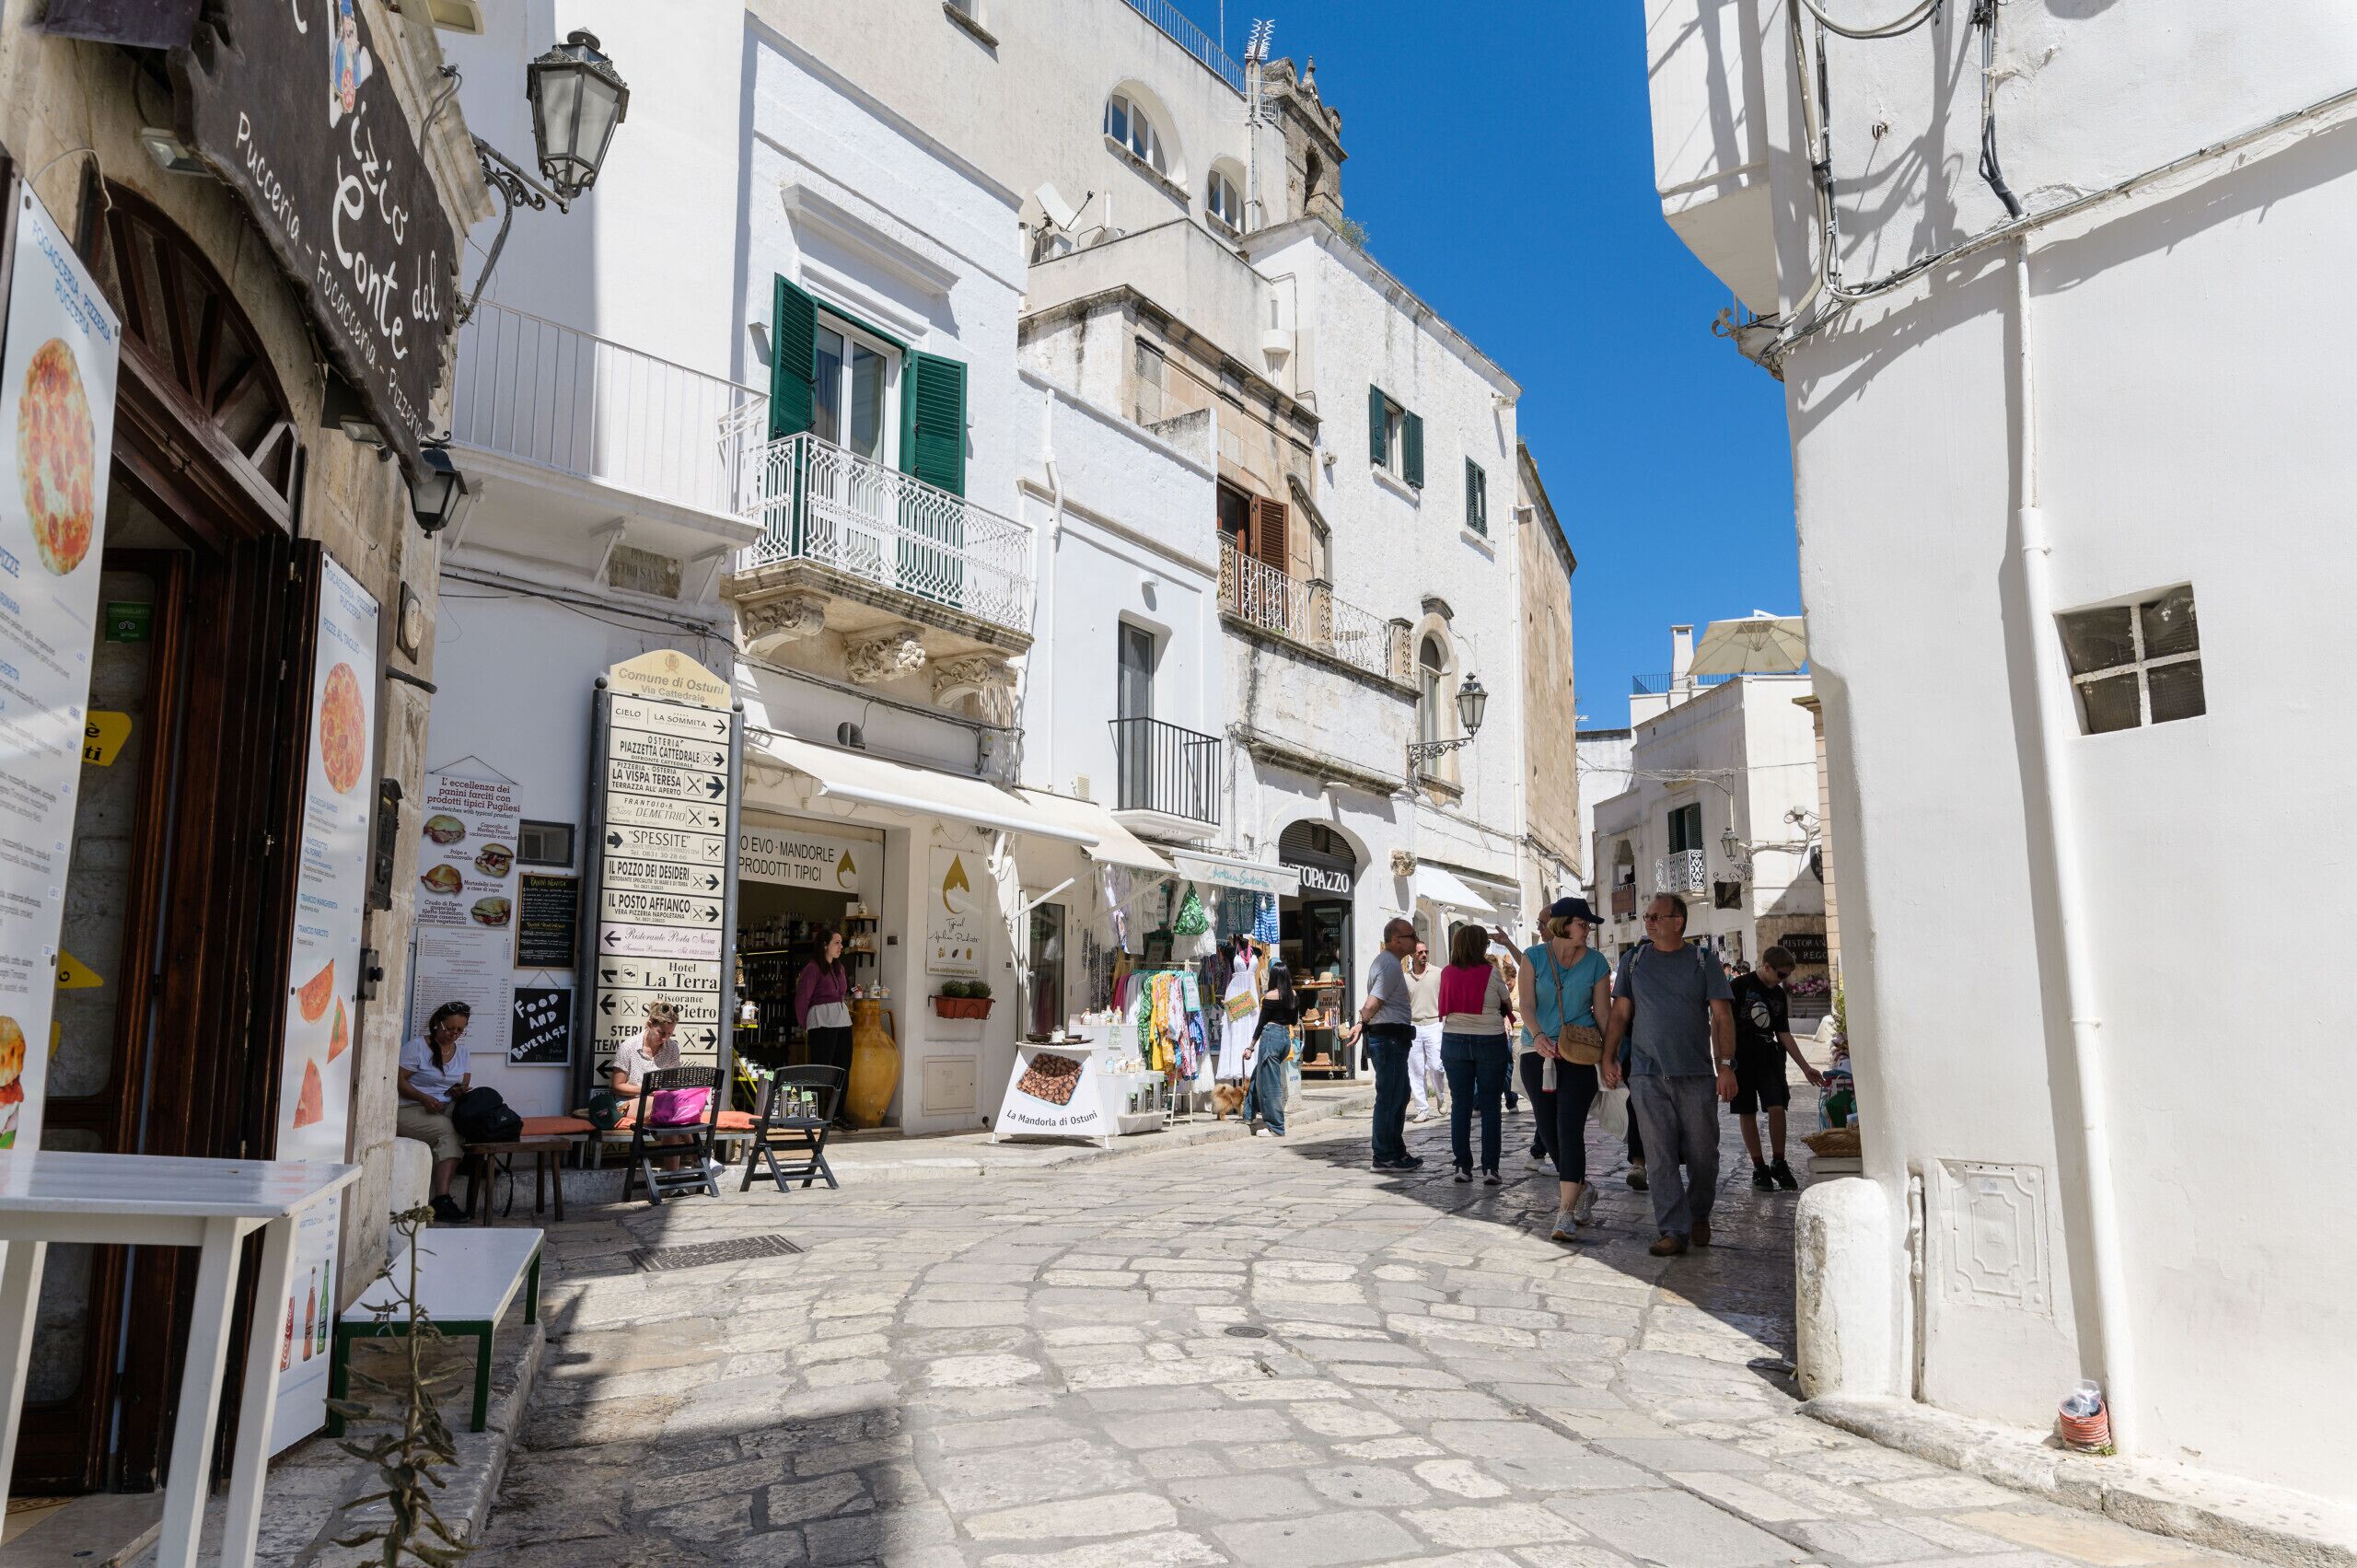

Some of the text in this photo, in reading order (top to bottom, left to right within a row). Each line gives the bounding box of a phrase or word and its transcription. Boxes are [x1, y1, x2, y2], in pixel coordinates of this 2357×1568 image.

[332, 154, 409, 360] Conte
[236, 111, 423, 447] Pucceria Focacceria Pizzeria
[412, 250, 441, 322] del
[619, 668, 725, 695] Comune di Ostuni
[641, 684, 656, 695] Via
[615, 708, 641, 717] CIELO
[667, 715, 707, 727] SOMMITA
[84, 745, 102, 761] ti
[620, 740, 700, 763] PIAZZETTA CATTEDRALE
[617, 761, 677, 774] PIZZERIA OSTERIA
[631, 754, 693, 769] DIFRONTE CATTEDRALE
[612, 768, 681, 787] LA VISPA TERESA
[438, 788, 511, 803] panini farciti con
[449, 781, 494, 792] eccellenza
[496, 784, 510, 794] dei
[611, 781, 644, 791] TERRAZZA
[658, 786, 681, 796] APERTO
[426, 796, 521, 813] prodotti tipici Pugliesi
[431, 806, 462, 814] sandwiches
[475, 809, 493, 818] typical
[635, 807, 686, 821] DEMETRIO
[751, 836, 773, 854] EVO
[780, 841, 834, 863] MANDORLE
[609, 860, 690, 881] IL POZZO DEI DESIDERI
[738, 856, 821, 881] PRODOTTI TIPICI
[609, 875, 632, 884] RISTORANTE
[609, 893, 691, 913] IL POSTO AFFIANCO
[653, 912, 685, 920] NAPOLETANA
[624, 927, 665, 940] Ristorante
[668, 929, 690, 942] Porta
[1782, 939, 1827, 947] RISTORAN
[668, 962, 696, 973] Hotel
[644, 971, 717, 990] La Terra
[515, 993, 559, 1018] FOOD
[656, 993, 703, 1004] Ristorante
[529, 1011, 557, 1029] AND
[511, 1025, 567, 1060] BEVERAGE
[1006, 1109, 1097, 1126] La Mandorla di Ostuni
